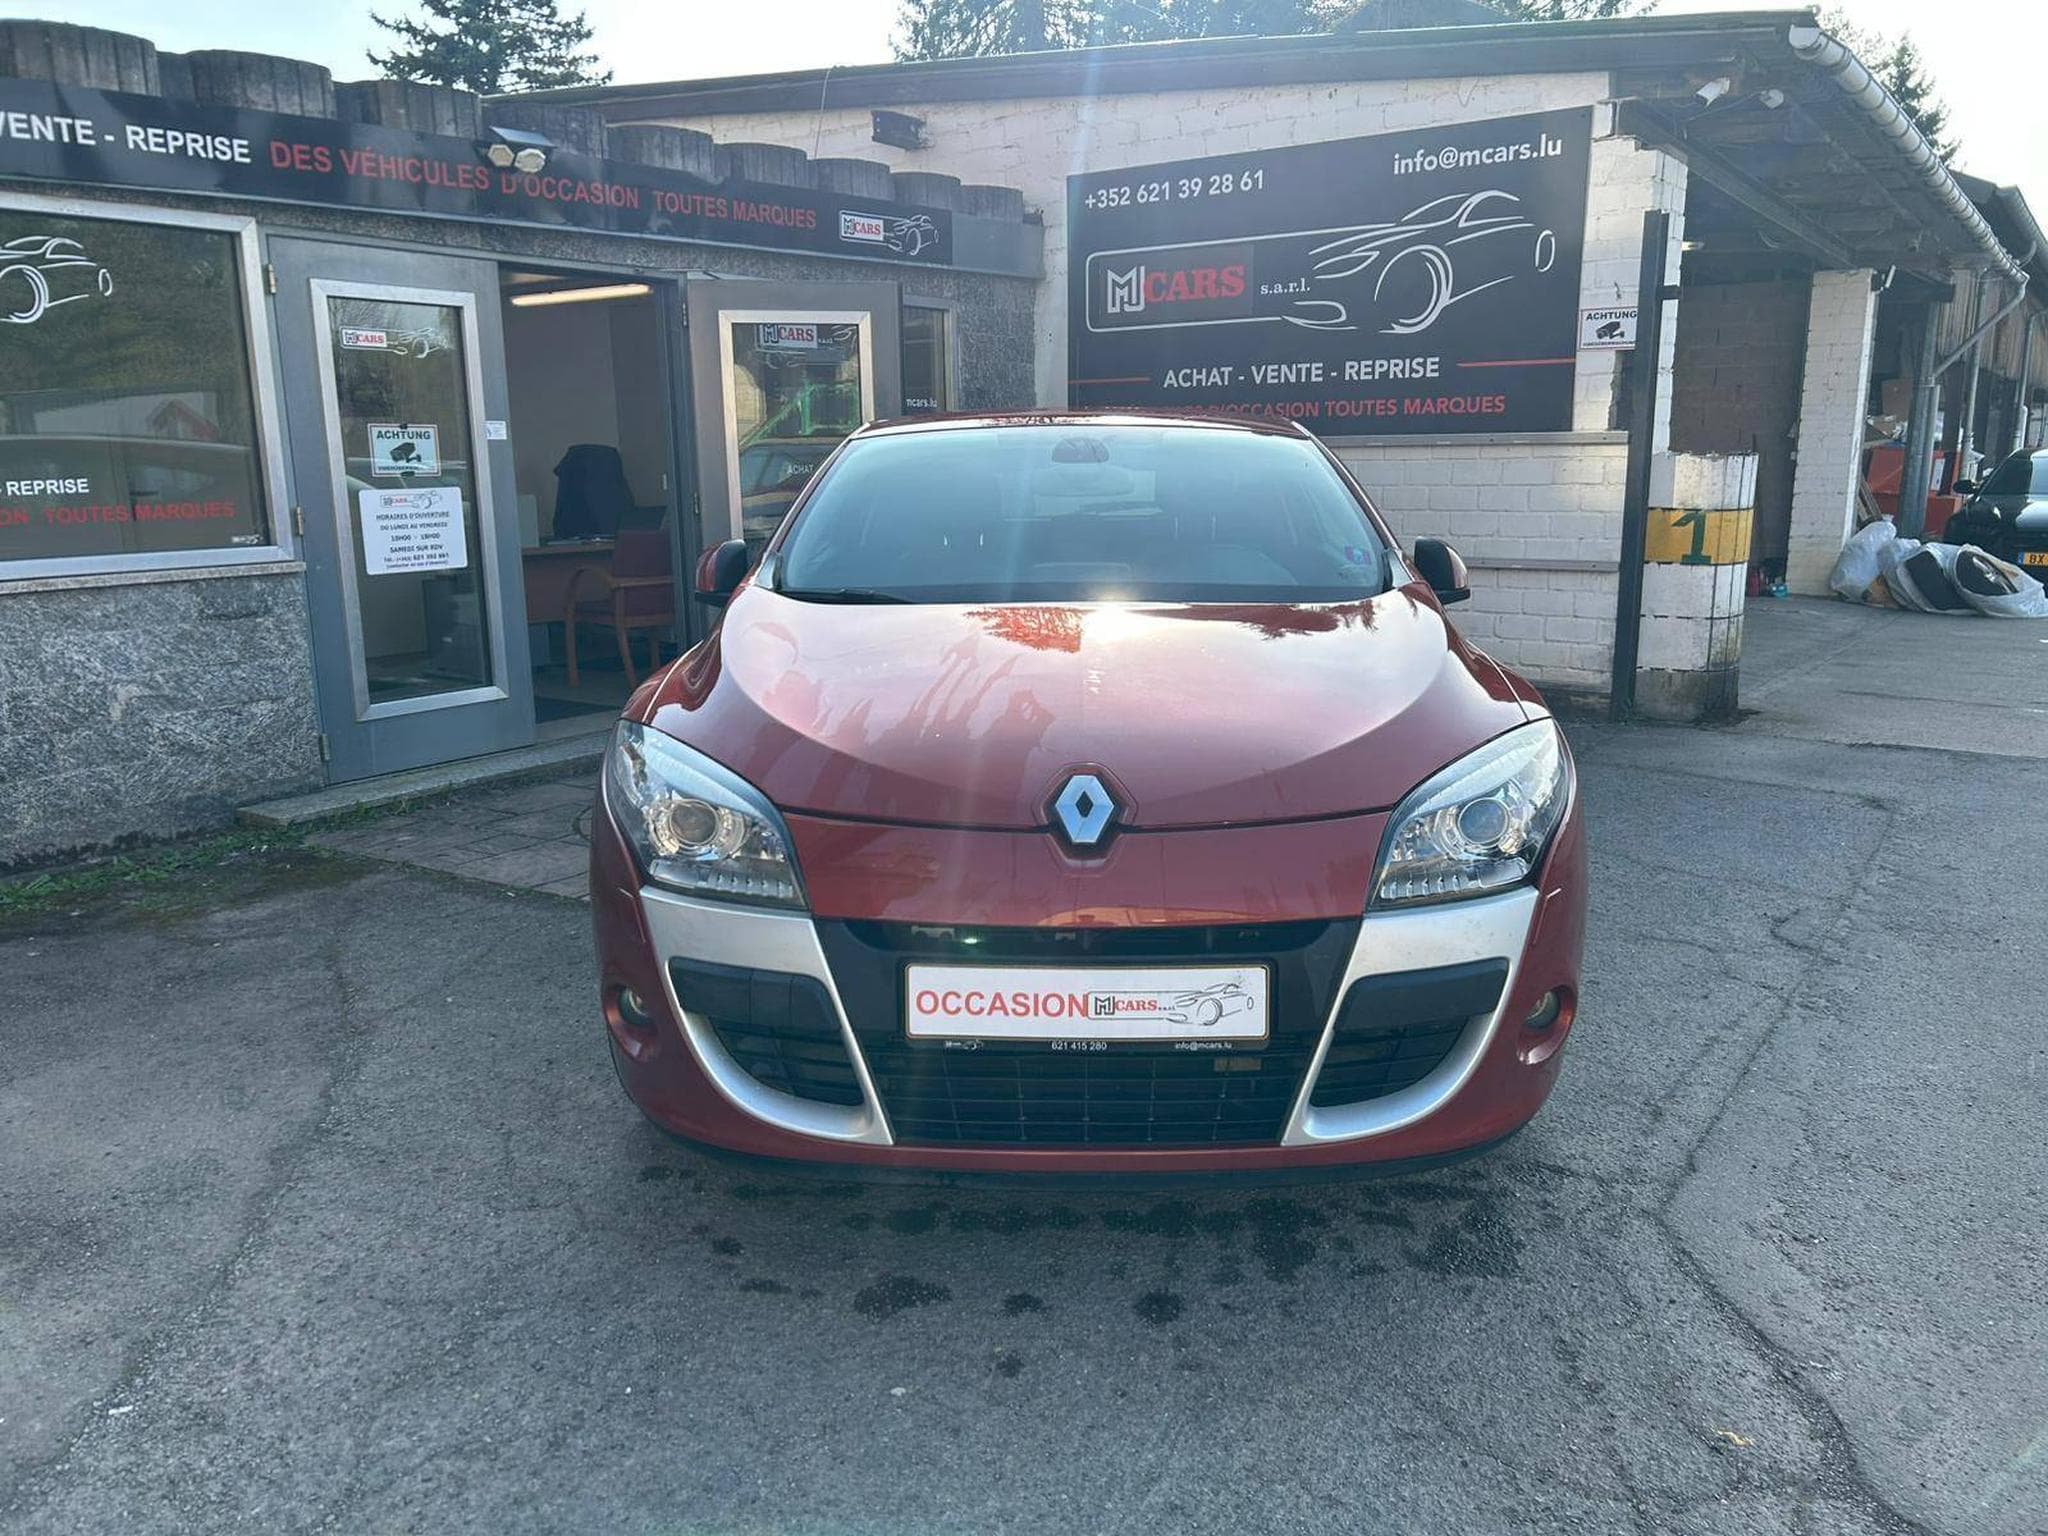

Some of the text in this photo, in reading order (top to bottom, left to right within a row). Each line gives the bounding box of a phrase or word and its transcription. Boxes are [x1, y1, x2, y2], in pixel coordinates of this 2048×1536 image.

[1394, 134, 1562, 175] info@mcars.lu
[0, 112, 96, 146] ENTE
[125, 125, 251, 163] REPRISE
[269, 141, 332, 173] DES
[340, 146, 490, 190] VÉHICULES
[501, 173, 640, 209] D'OCCASION
[653, 190, 728, 218] TOUTES
[733, 200, 816, 230] MARQUES
[1085, 169, 1263, 209] +352 621 39 28 61
[1260, 278, 1311, 295] s.a.r.l.
[1586, 311, 1637, 320] ACHTUNG
[1164, 366, 1233, 388] ACHAT
[1251, 362, 1323, 384] VENTE
[1344, 357, 1440, 381] REPRISE
[1325, 399, 1397, 417] TOUTES
[1403, 395, 1505, 415] MARQUES
[376, 430, 431, 440] ACHTUNG
[6, 478, 90, 496] REPRISE
[44, 503, 128, 526] TOUTES
[135, 501, 236, 521] MARQUES
[1671, 511, 1712, 565] 1
[916, 990, 1089, 1018] OCCASION
[1051, 1040, 1068, 1050] 621
